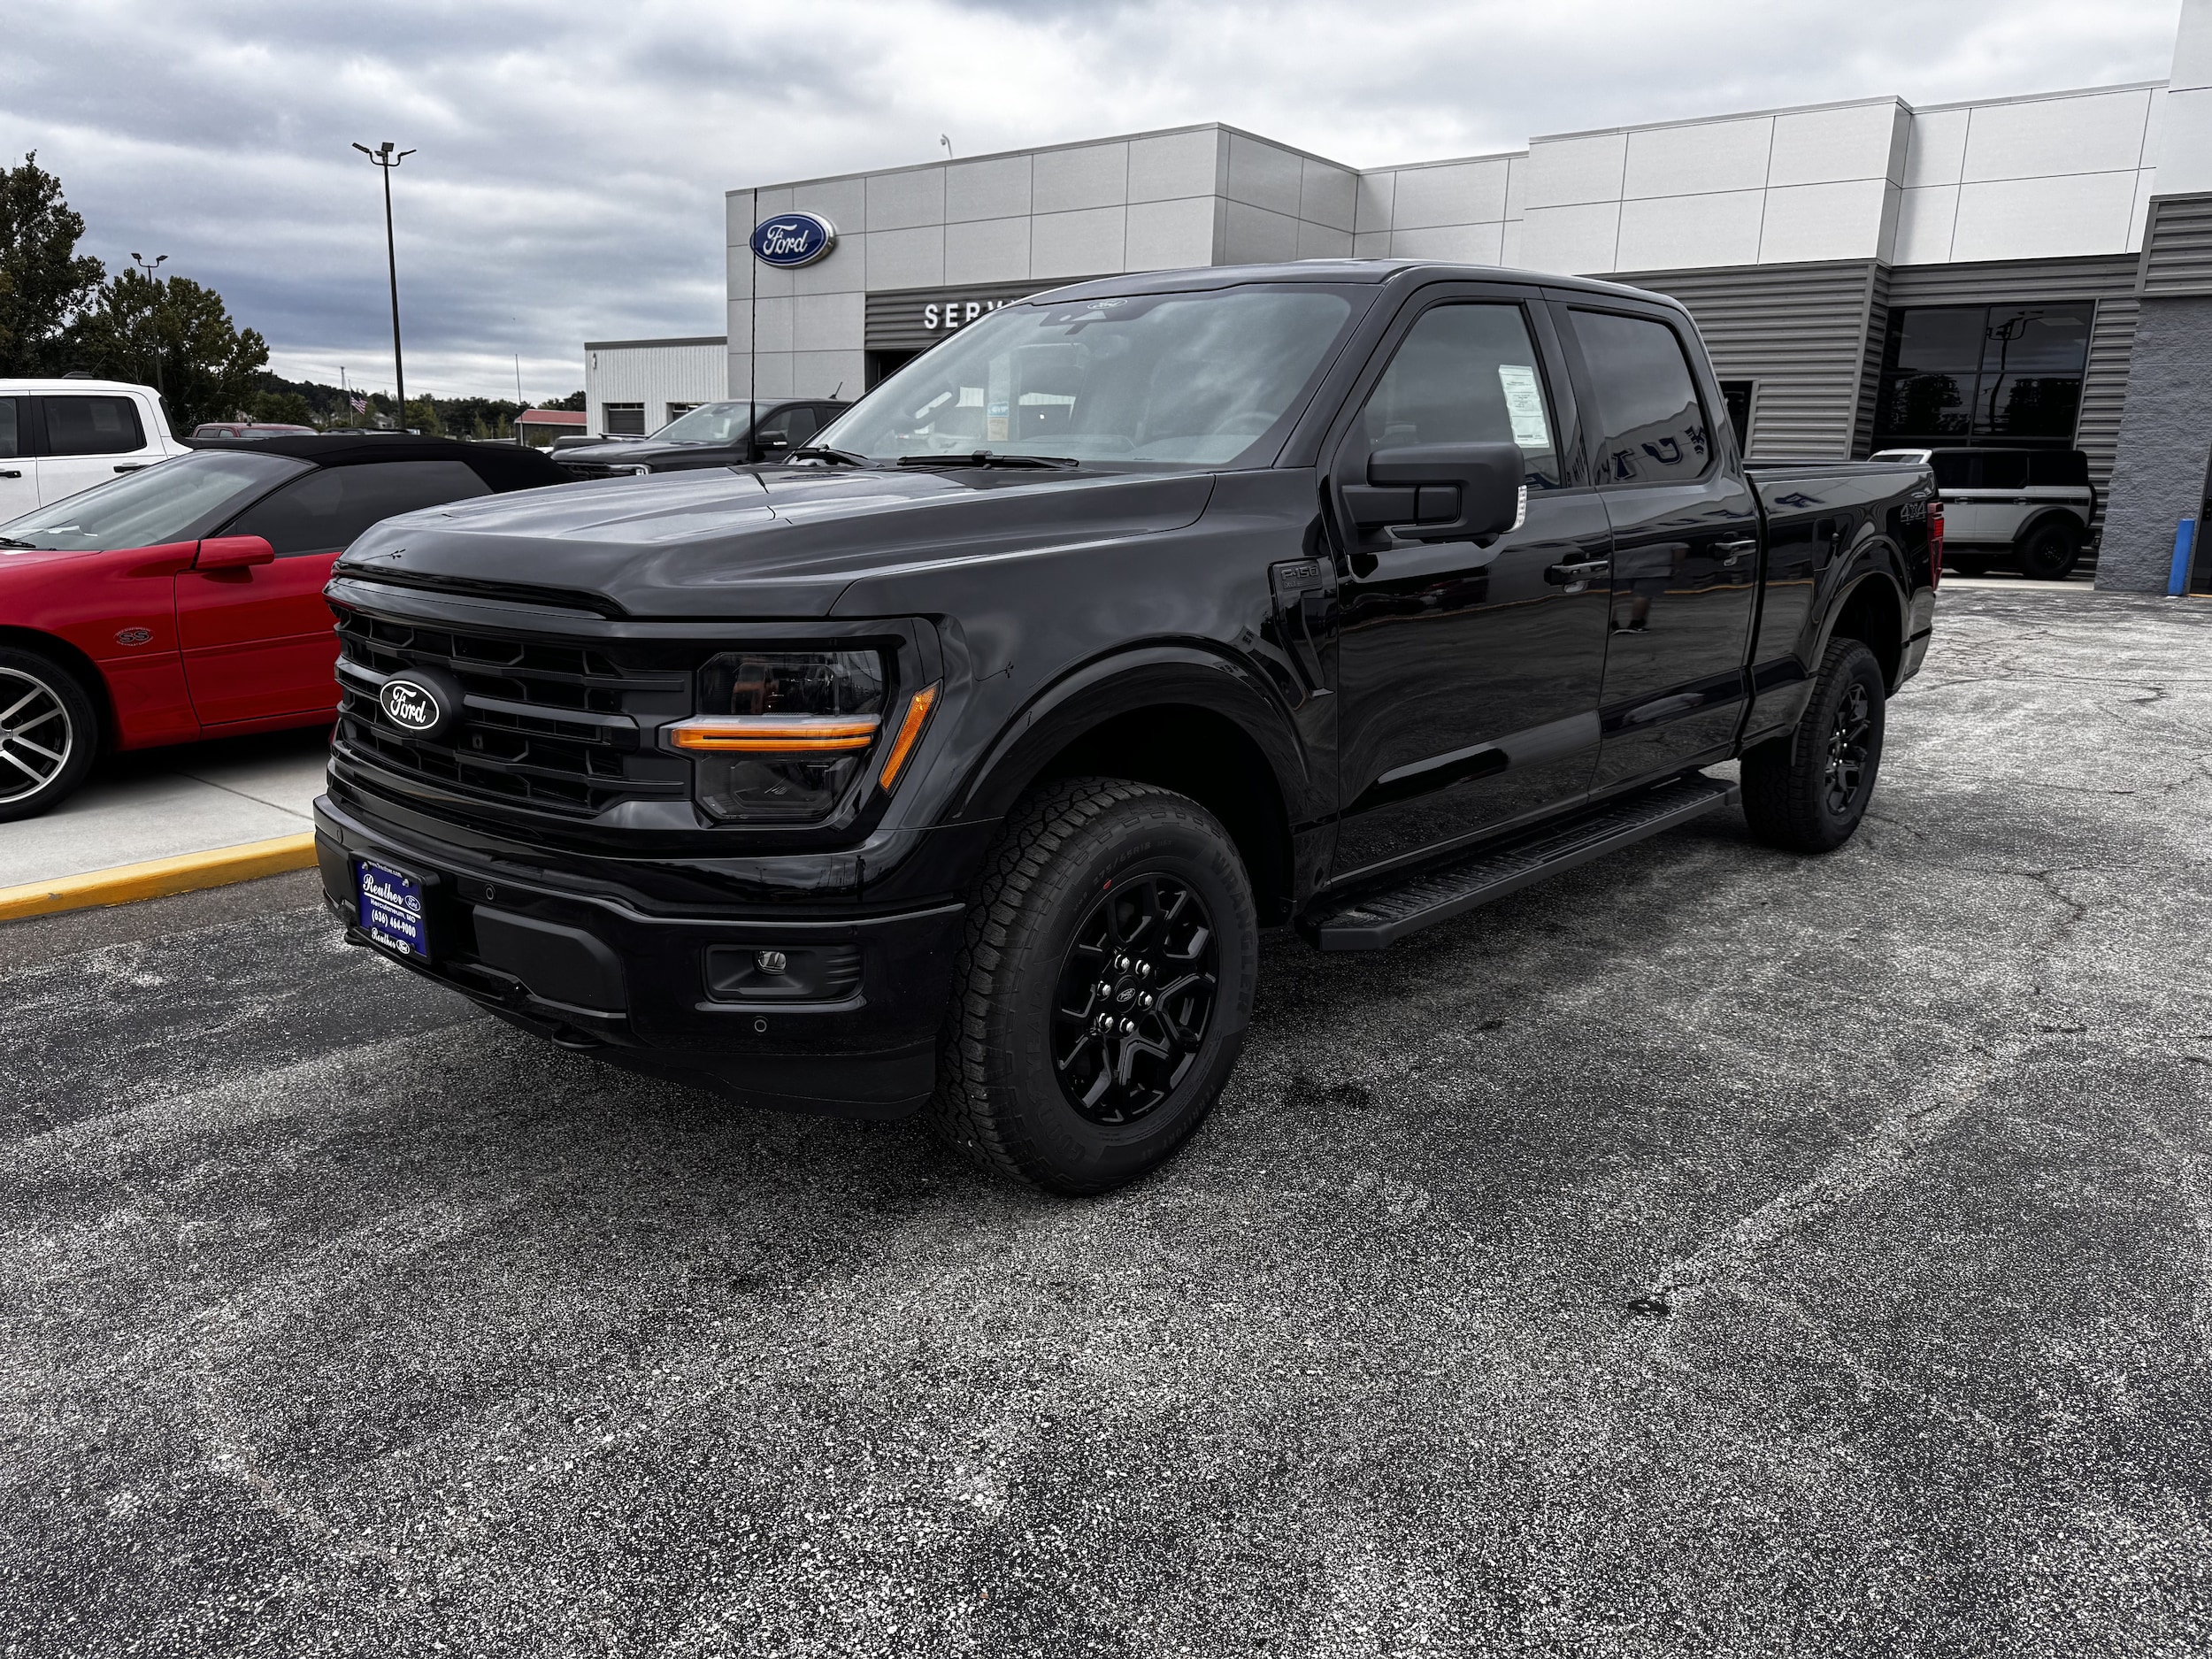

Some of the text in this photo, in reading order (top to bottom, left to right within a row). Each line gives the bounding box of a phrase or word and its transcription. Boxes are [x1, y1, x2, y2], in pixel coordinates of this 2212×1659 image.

[763, 224, 809, 256] Ford
[924, 301, 1016, 329] SER
[119, 631, 150, 642] SS
[390, 686, 426, 723] Ford
[363, 873, 404, 905] Reuther
[372, 909, 417, 938] (636) 464-9000
